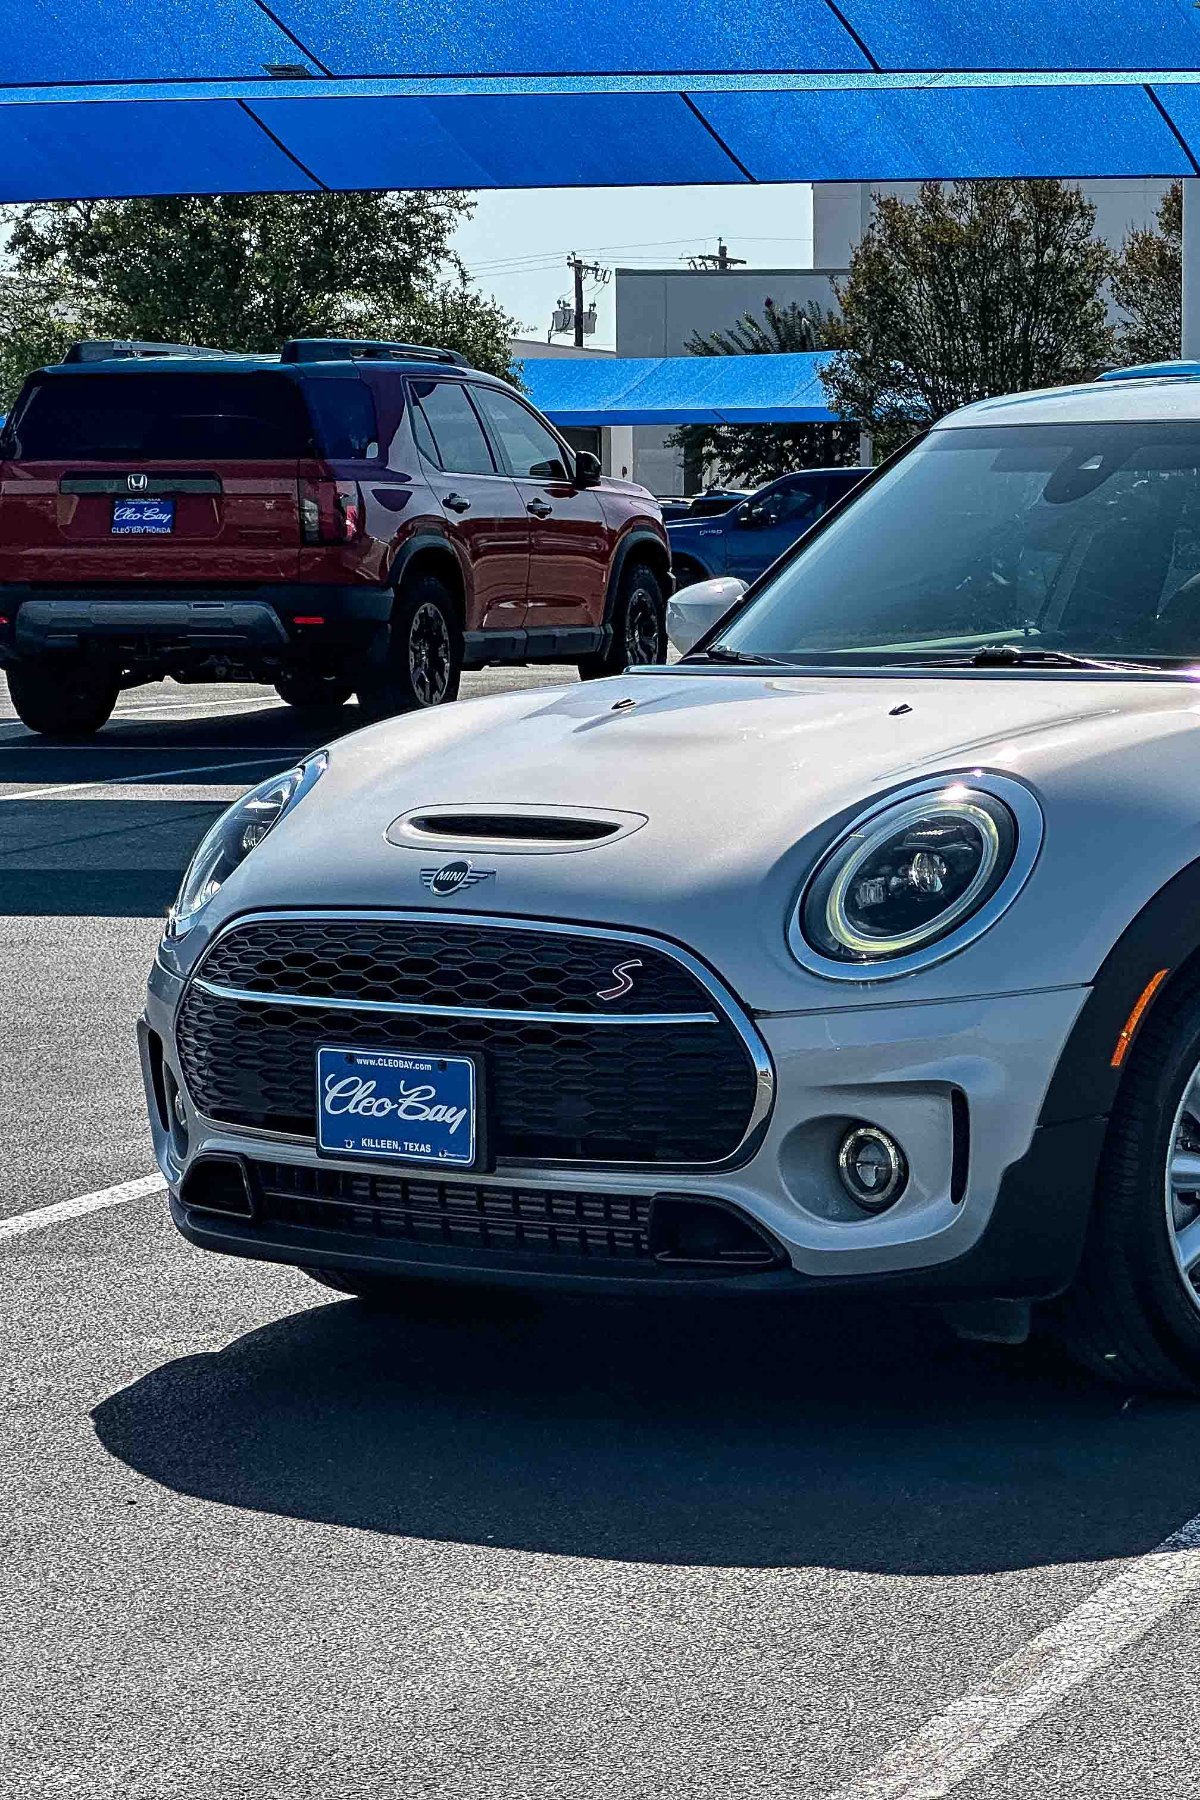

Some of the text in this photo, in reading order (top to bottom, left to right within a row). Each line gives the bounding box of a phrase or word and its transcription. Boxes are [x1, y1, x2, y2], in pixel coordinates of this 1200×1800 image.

[114, 507, 171, 523] Cleo Bay
[436, 871, 465, 881] MINI
[597, 959, 643, 1000] S
[356, 1057, 432, 1071] www.CLEOBAY.com
[325, 1074, 467, 1135] Cleo Bay
[361, 1137, 431, 1153] KILLEEN, TEXAS
